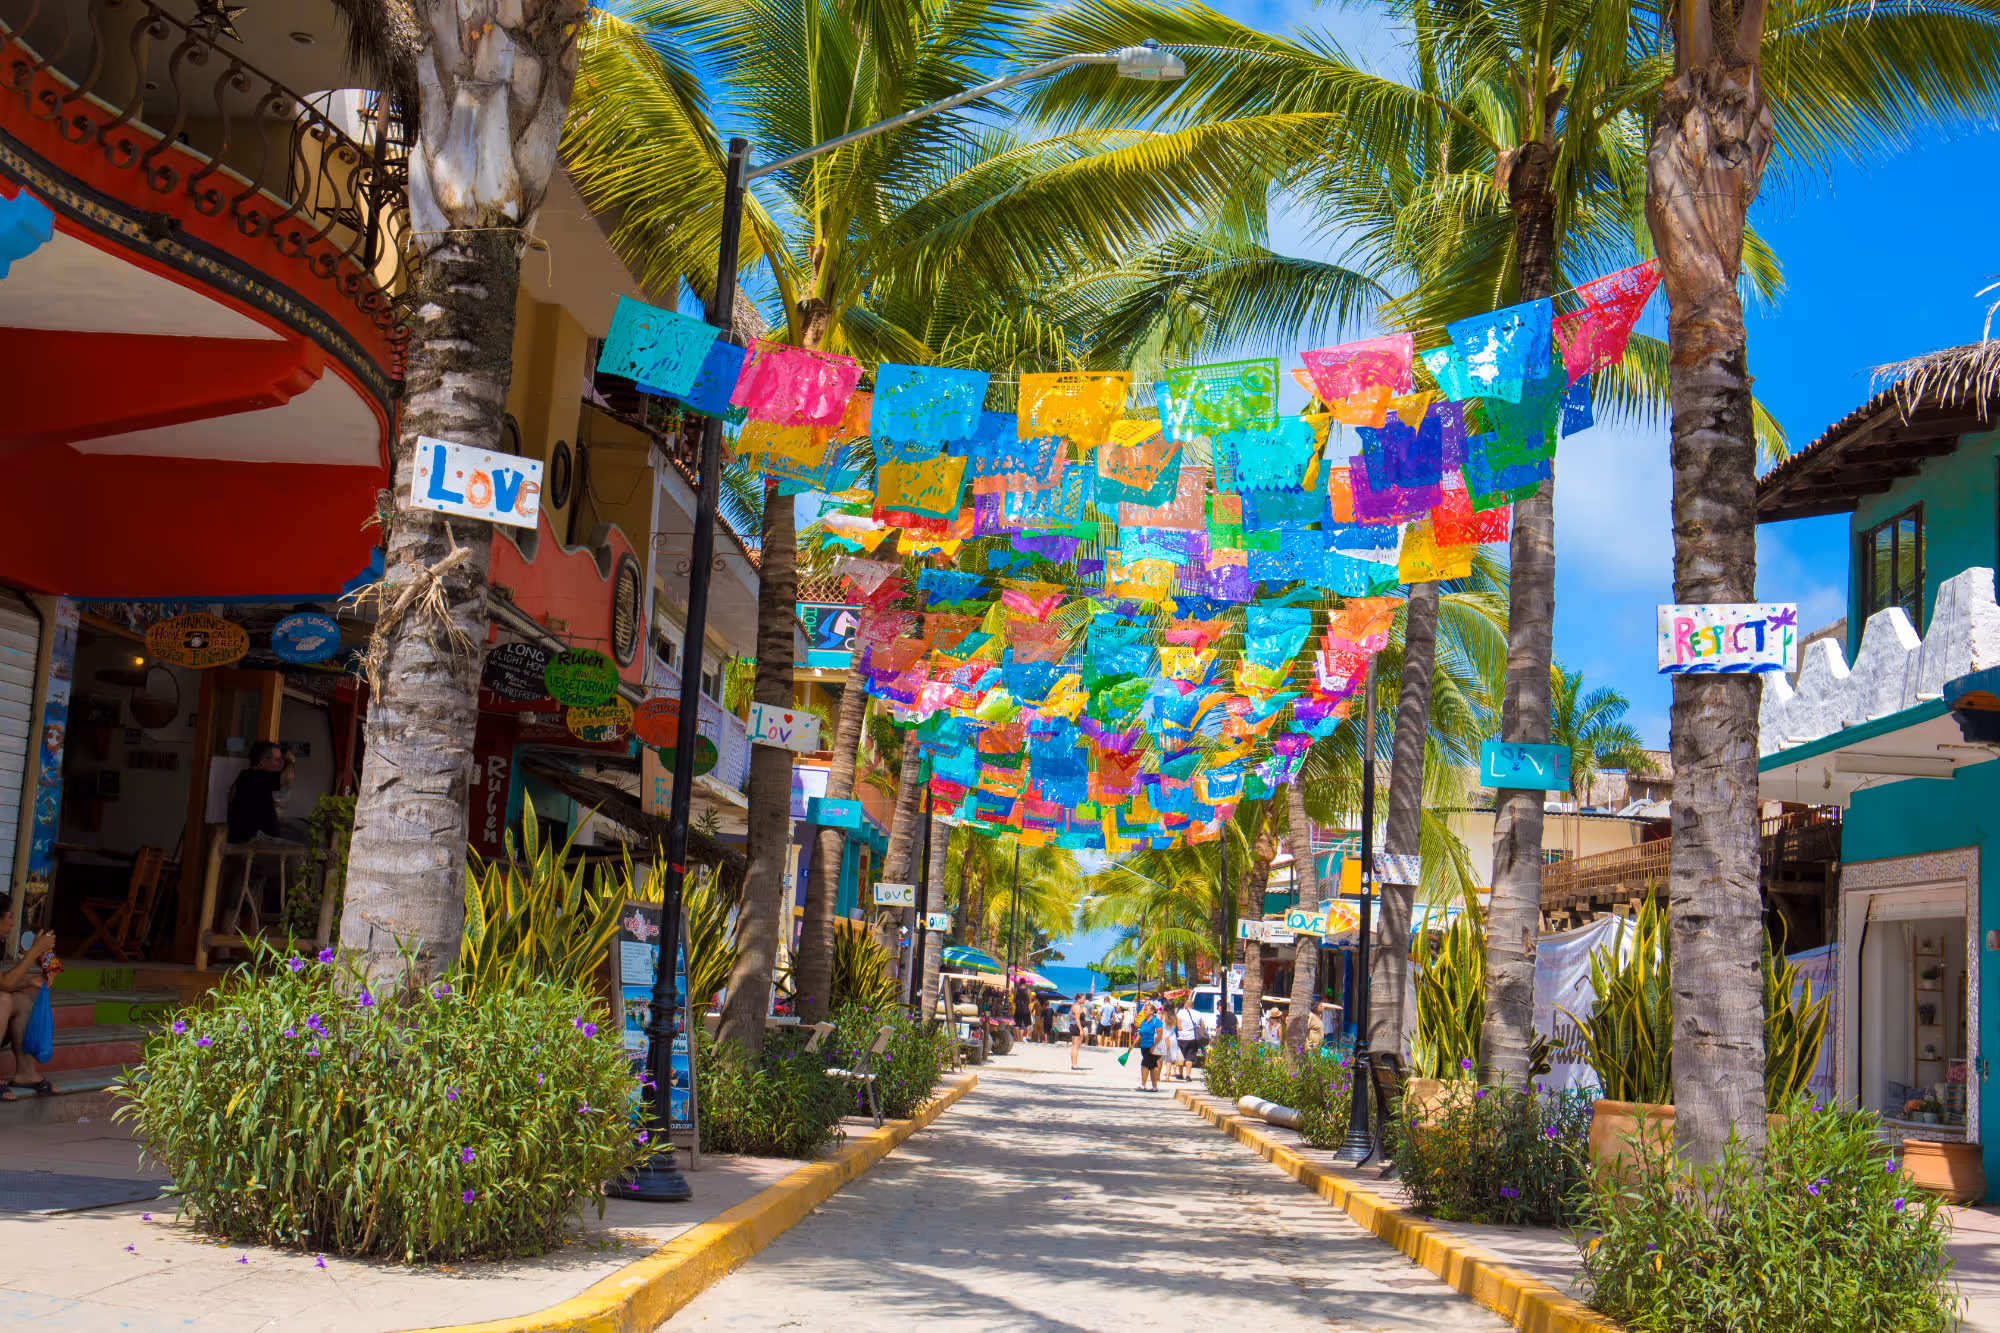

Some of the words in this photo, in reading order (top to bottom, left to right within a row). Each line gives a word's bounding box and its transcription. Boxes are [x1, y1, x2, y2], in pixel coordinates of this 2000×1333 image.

[169, 615, 225, 630] THINKING
[1674, 616, 1767, 665] RESPECT
[492, 650, 524, 665] FLIGHT
[526, 660, 547, 673] HOM
[507, 643, 545, 662] LONG
[558, 651, 604, 668] Ruben
[549, 676, 613, 695] VEGETARIAN
[560, 689, 594, 705] dishes
[588, 707, 626, 718] Mejores
[612, 716, 632, 724] TODA
[483, 755, 508, 844] Ruben
[1287, 912, 1327, 934] LOVE
